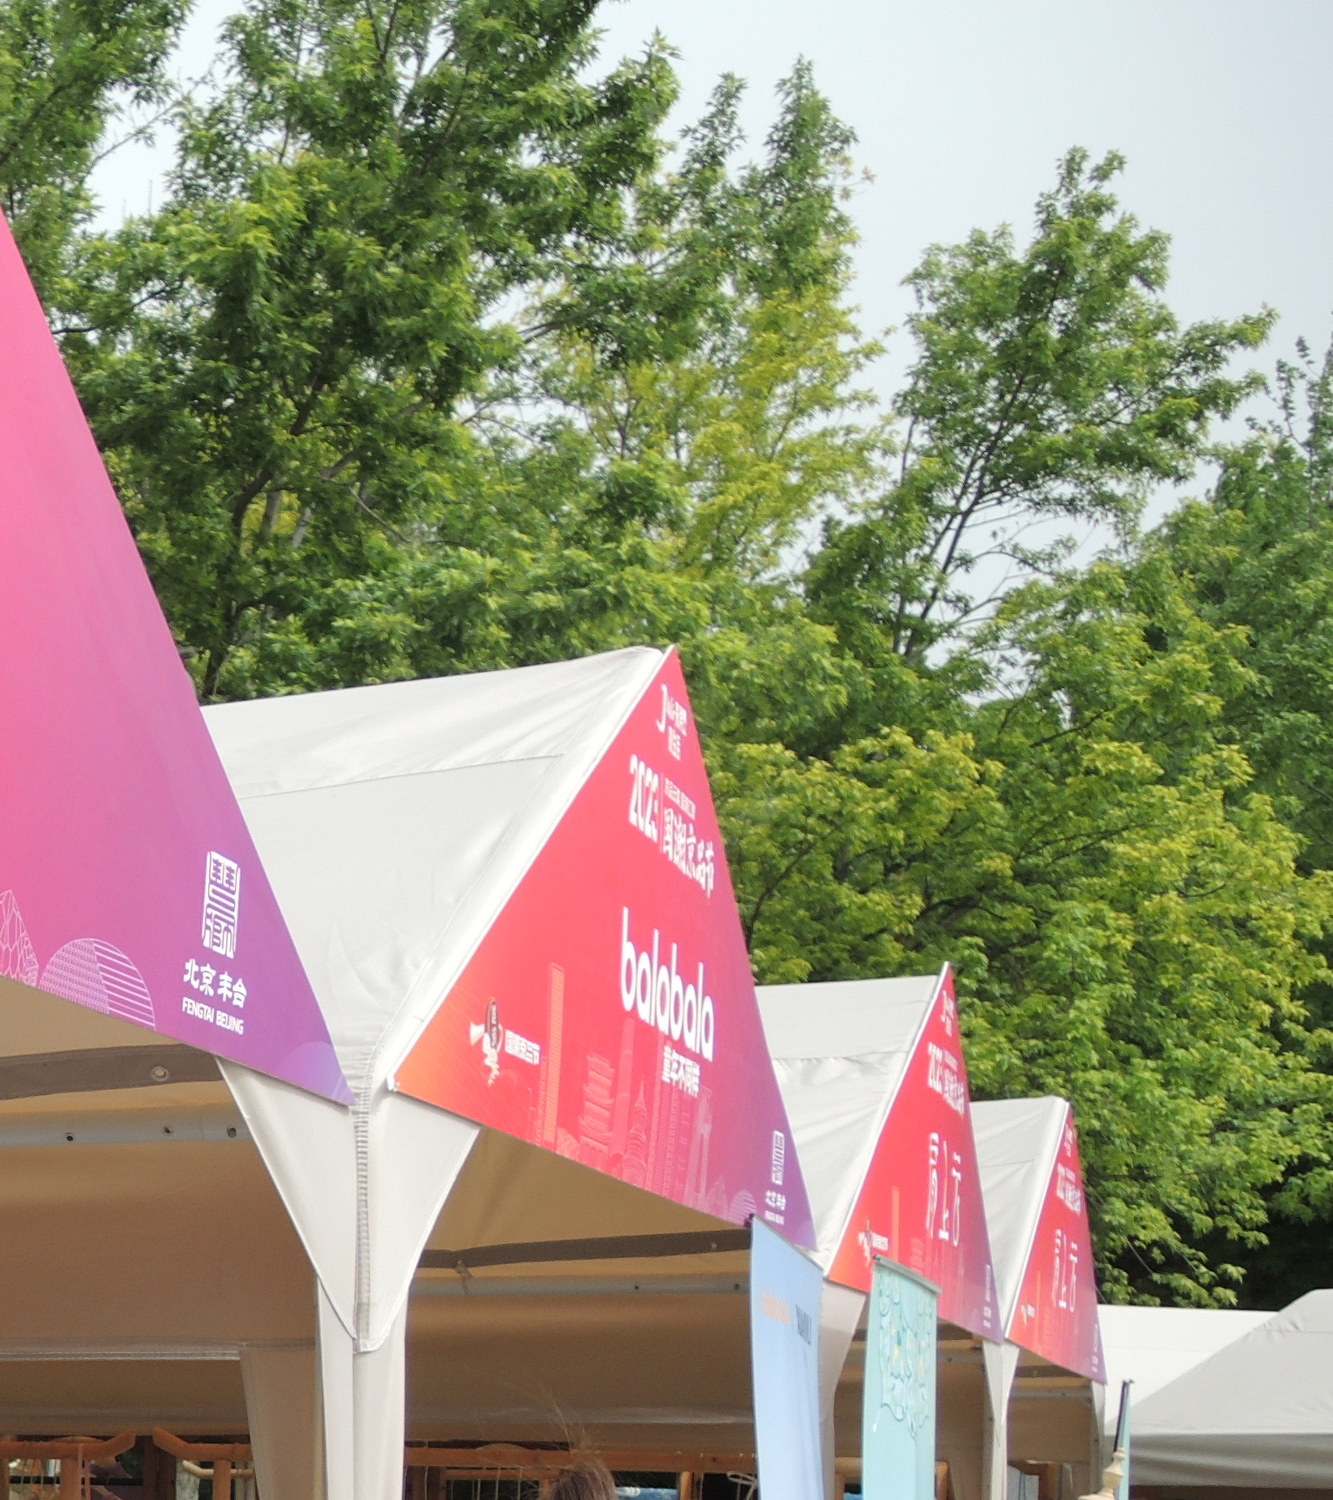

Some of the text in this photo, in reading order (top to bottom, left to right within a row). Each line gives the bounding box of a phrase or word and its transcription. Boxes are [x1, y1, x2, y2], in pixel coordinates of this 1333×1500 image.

[183, 957, 216, 997] 北京
[621, 905, 715, 1063] balabala
[182, 996, 244, 1035] FENGTAI BEIJING
